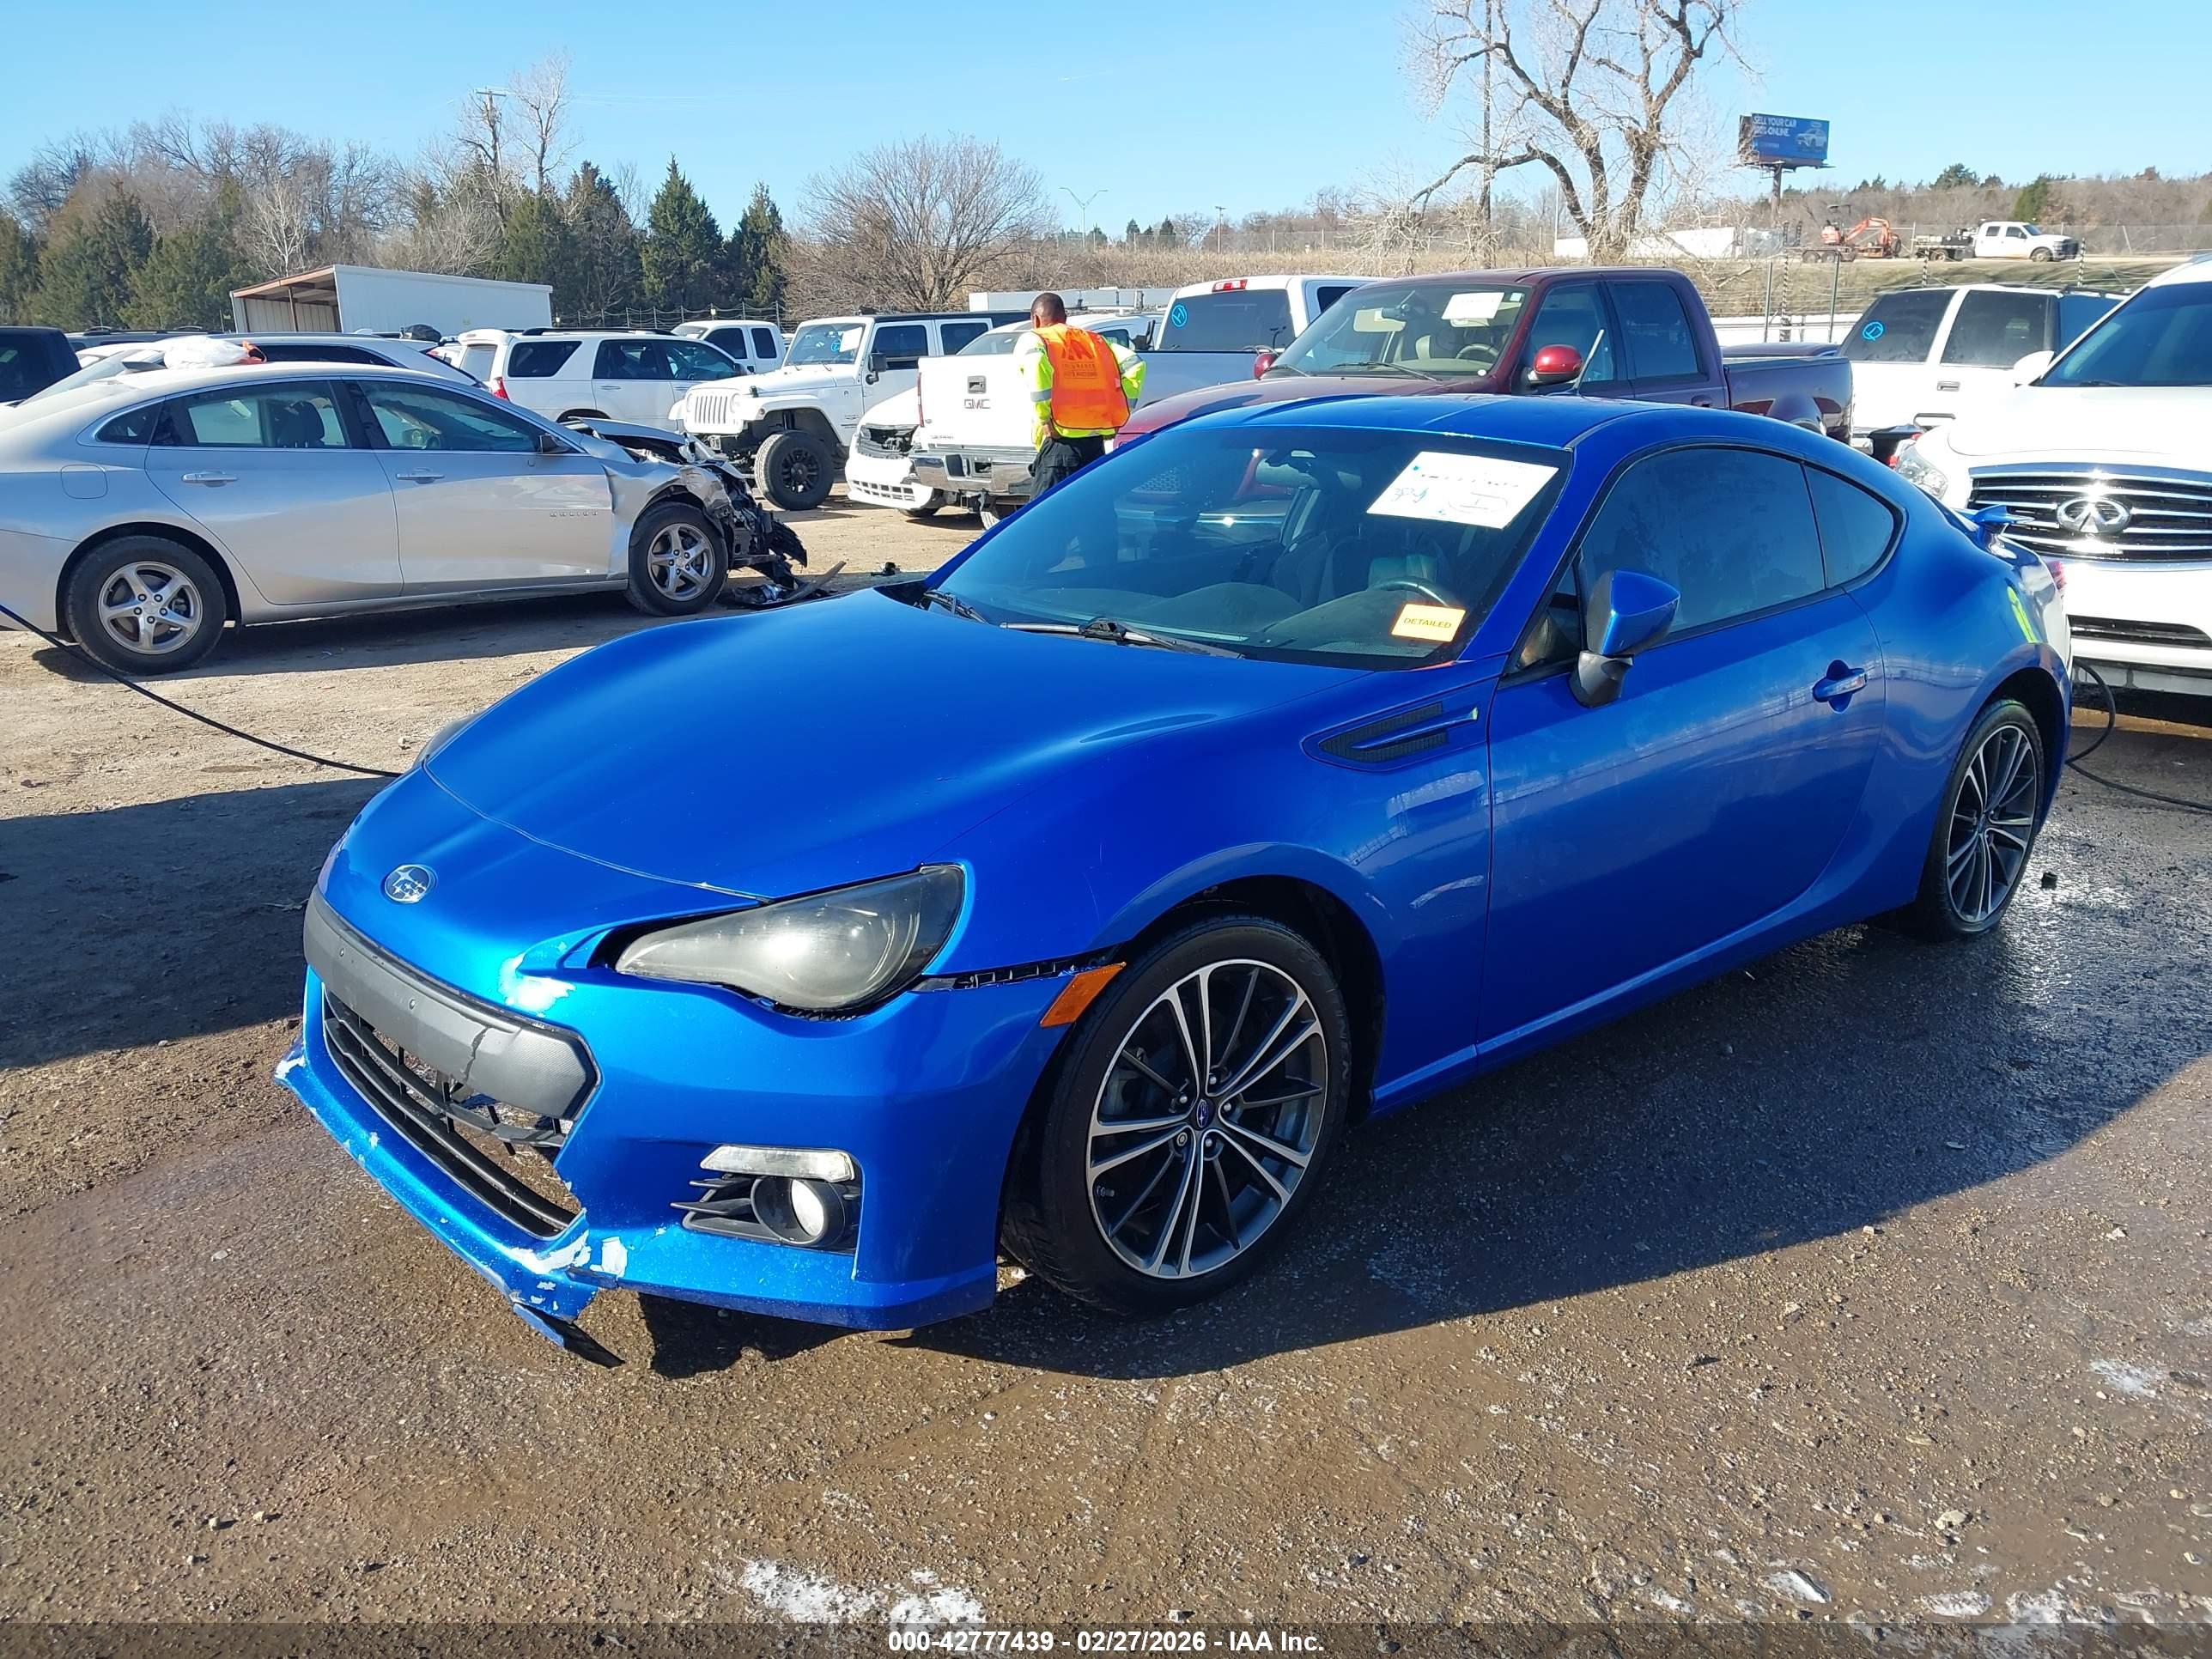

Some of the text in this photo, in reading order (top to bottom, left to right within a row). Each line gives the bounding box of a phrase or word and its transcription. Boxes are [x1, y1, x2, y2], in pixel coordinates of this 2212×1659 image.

[1753, 115, 1766, 125] SELL
[1768, 117, 1784, 126] YOUR
[963, 398, 991, 410] GMC
[1403, 617, 1452, 629] DETAILED
